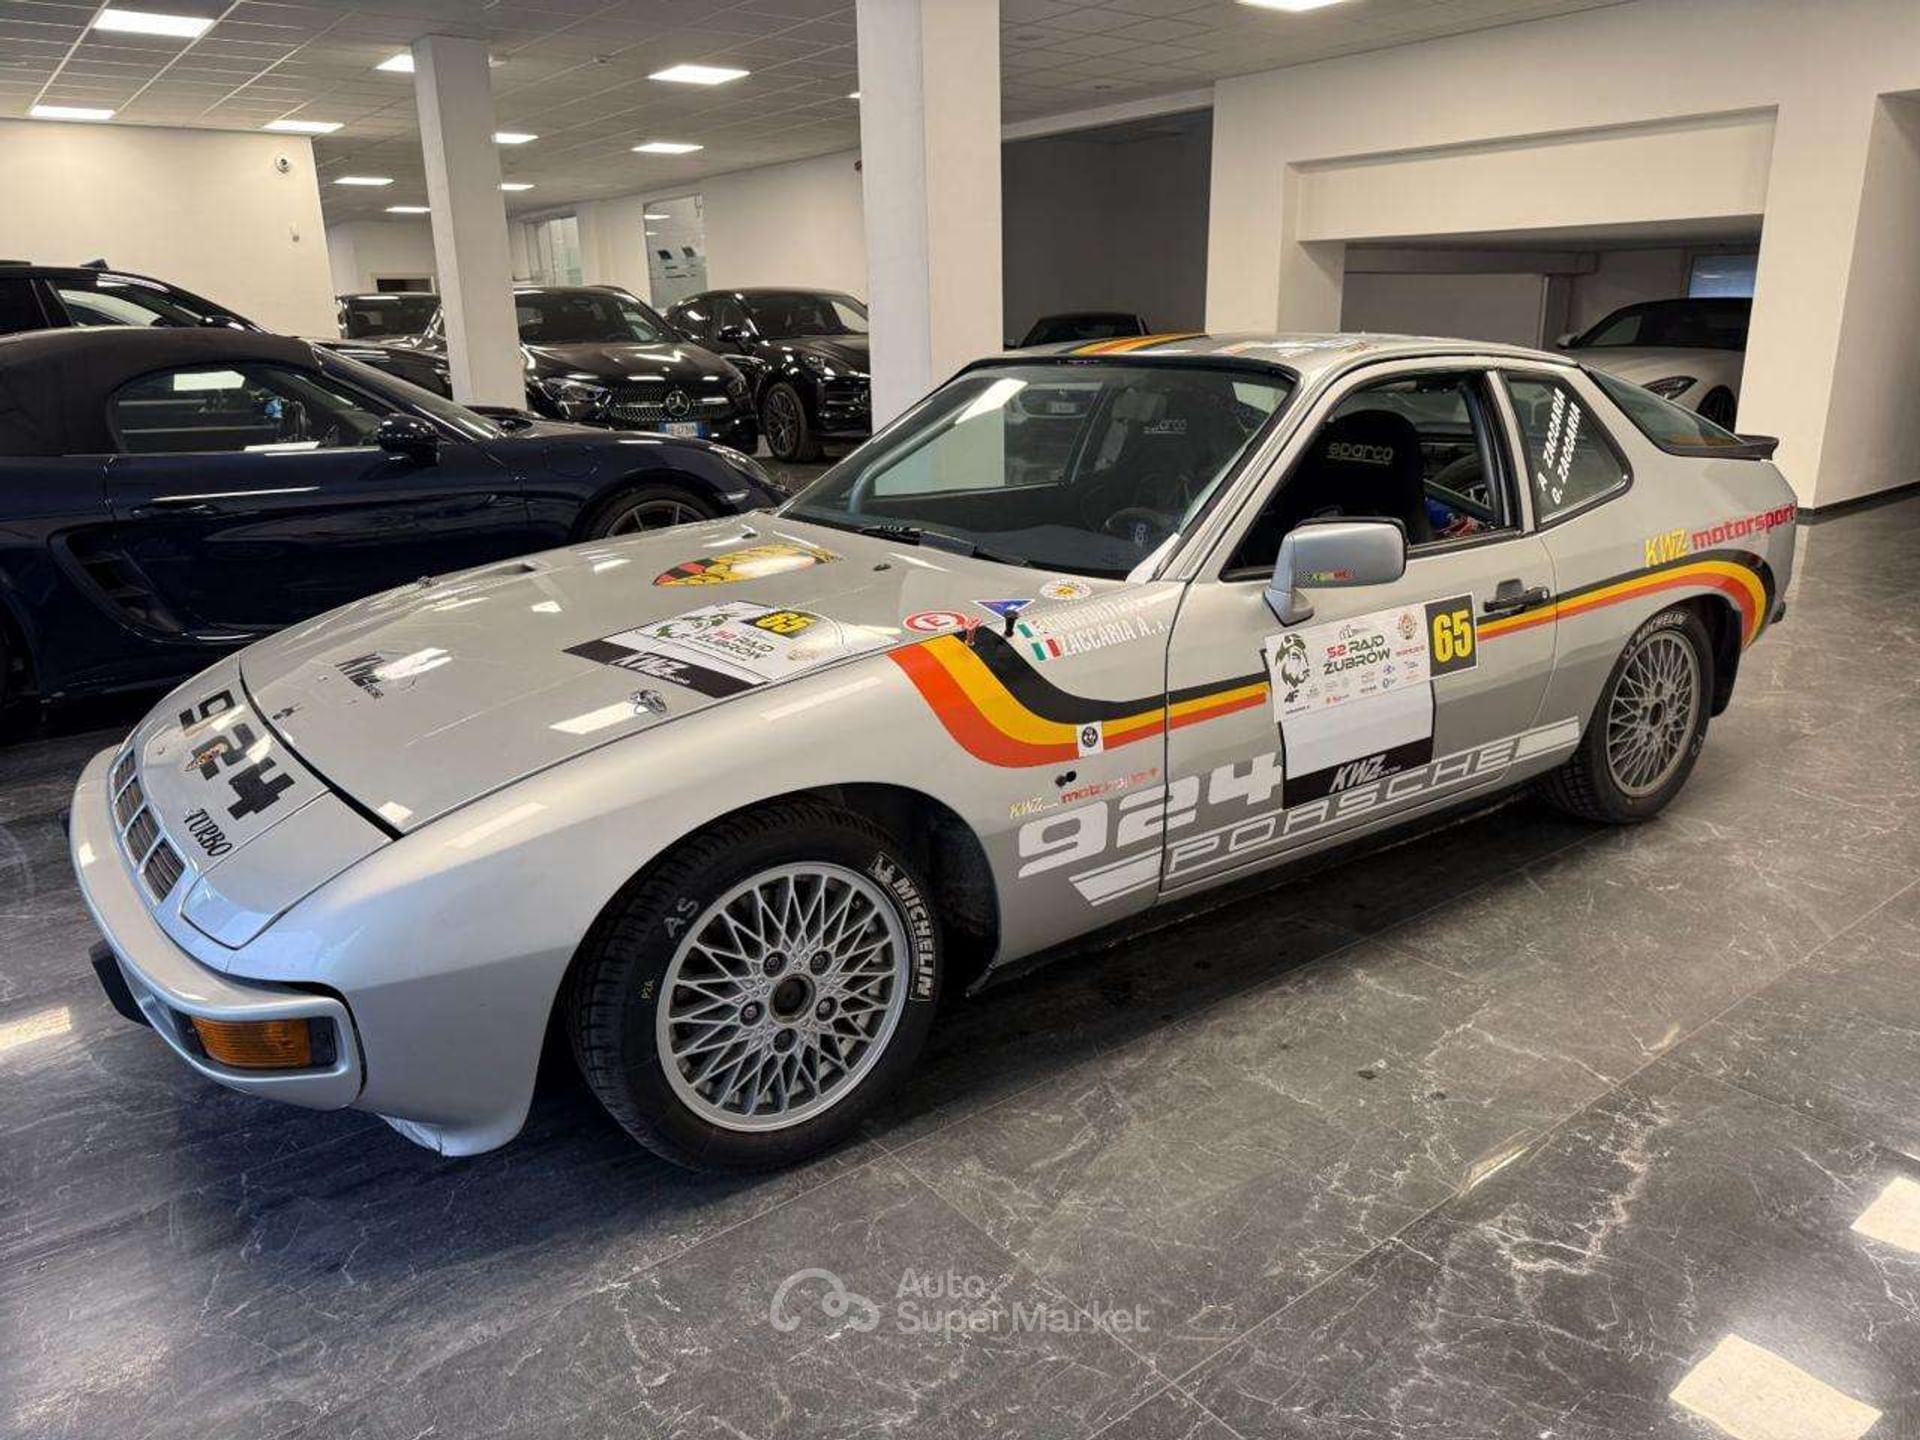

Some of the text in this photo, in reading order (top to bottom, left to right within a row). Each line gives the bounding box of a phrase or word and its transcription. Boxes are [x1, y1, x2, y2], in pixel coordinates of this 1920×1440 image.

[1543, 387, 1566, 469] ZACCARIA
[1557, 401, 1581, 484] ZACCARIA
[1644, 501, 1796, 567] KWZ motorsport
[1060, 619, 1138, 657] ZACCARIA
[1326, 645, 1347, 659] 52
[1348, 634, 1386, 655] RAID
[1433, 608, 1473, 662] 65
[178, 689, 296, 821] 924
[1328, 753, 1387, 794] KWZ
[184, 808, 233, 858] TURBO
[1017, 751, 1284, 878] 924
[1168, 737, 1519, 875] PORSCHE
[892, 878, 936, 1000] MICHELIN
